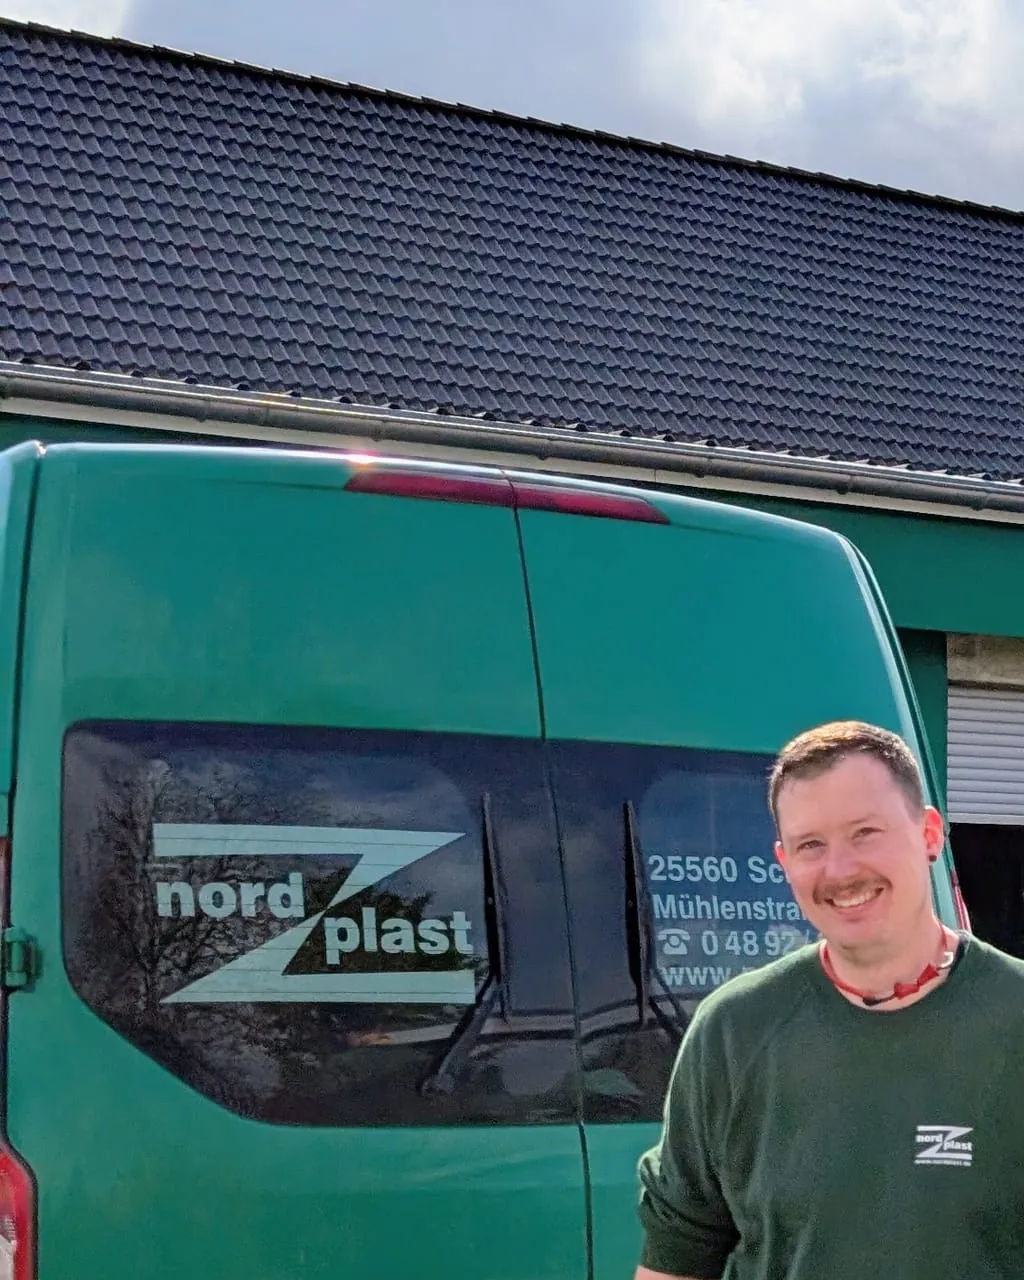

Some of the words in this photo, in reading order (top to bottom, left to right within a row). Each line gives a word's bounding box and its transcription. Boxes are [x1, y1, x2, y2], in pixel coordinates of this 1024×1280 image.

[648, 855, 738, 883] 25560
[155, 872, 305, 918] nord
[323, 907, 473, 964] plast
[915, 1133, 943, 1143] nord
[943, 1140, 973, 1151] plast
